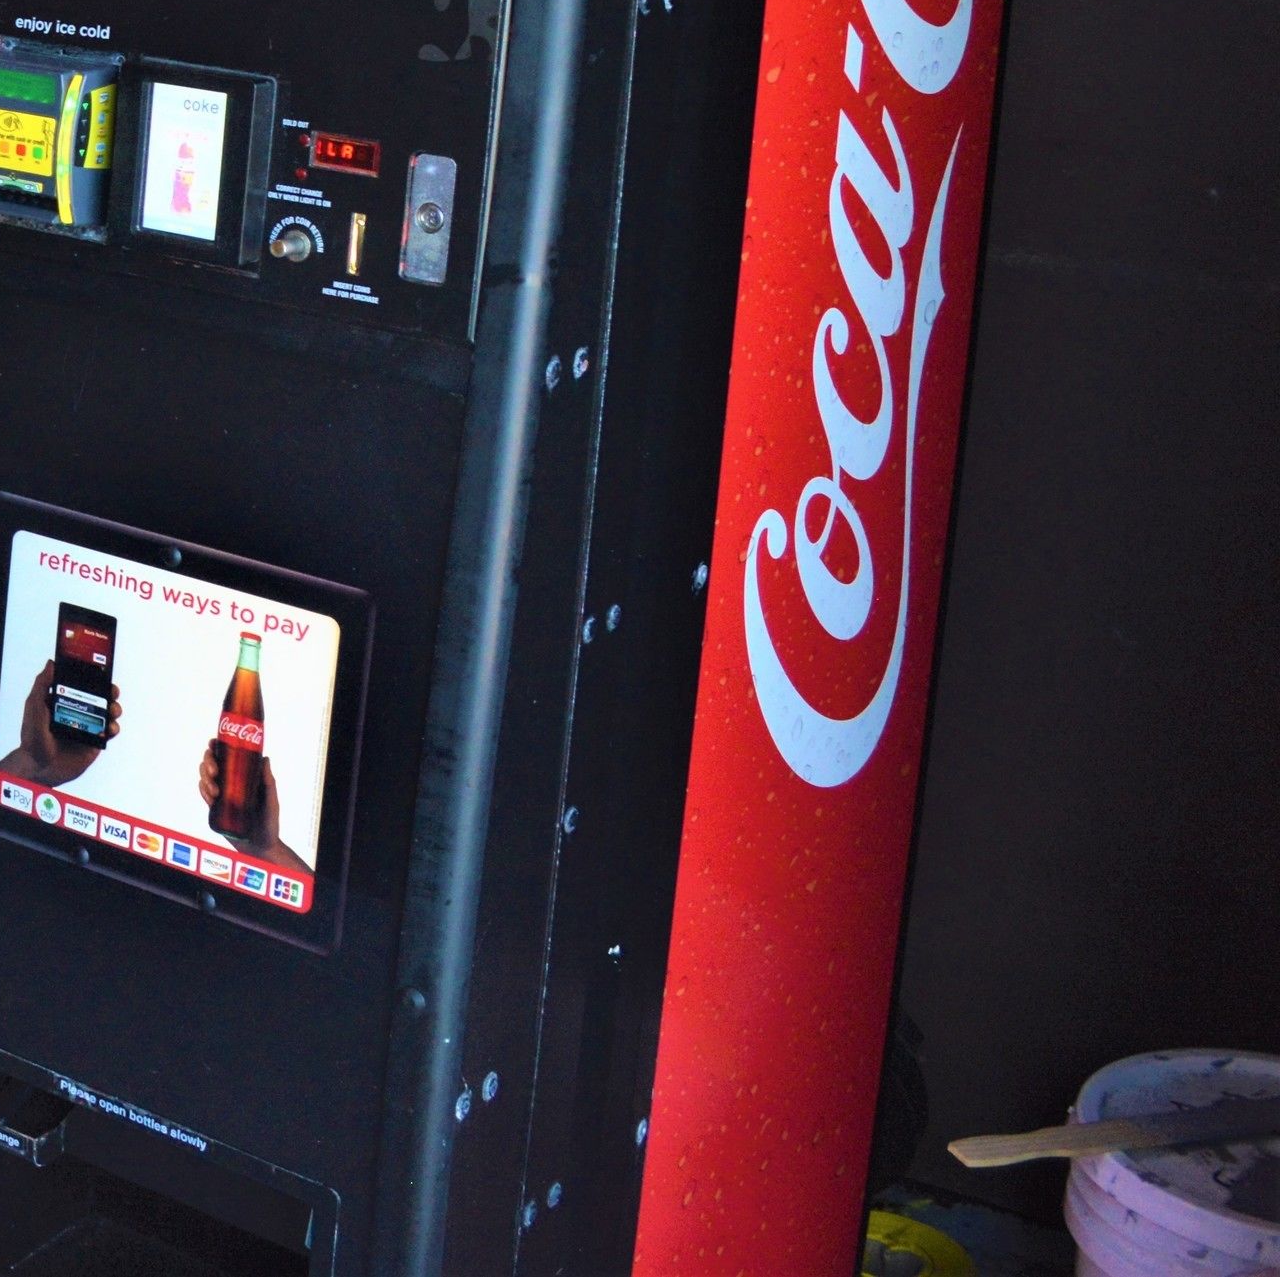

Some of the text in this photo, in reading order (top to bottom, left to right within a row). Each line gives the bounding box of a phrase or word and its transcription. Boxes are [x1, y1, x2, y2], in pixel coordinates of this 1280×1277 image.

[15, 15, 111, 40] enjoy ice cold
[183, 99, 219, 114] coke
[268, 191, 282, 199] ONLY
[283, 192, 299, 202] WHEN
[300, 195, 315, 204] LIGHT
[316, 198, 322, 206] IS
[276, 184, 323, 198] CORRECT CHANGE
[281, 216, 295, 227] FOR
[295, 216, 312, 228] COIN
[309, 224, 325, 253] RETURN
[333, 280, 371, 294] INSERT COINS
[322, 287, 379, 304] HERE FOR PURCHASE
[39, 548, 311, 642] refreshing ways to pay
[58, 697, 88, 712] MasterCard
[219, 716, 263, 745] Coca-Cola
[13, 789, 31, 808] Pay
[40, 809, 56, 821] pay
[67, 808, 96, 823] SAMSUNG
[72, 817, 89, 829] pay
[103, 822, 128, 841] VISA
[203, 857, 229, 870] DISCOVER
[274, 880, 298, 900] JCB
[60, 1079, 207, 1152] Please open bottles slowly
